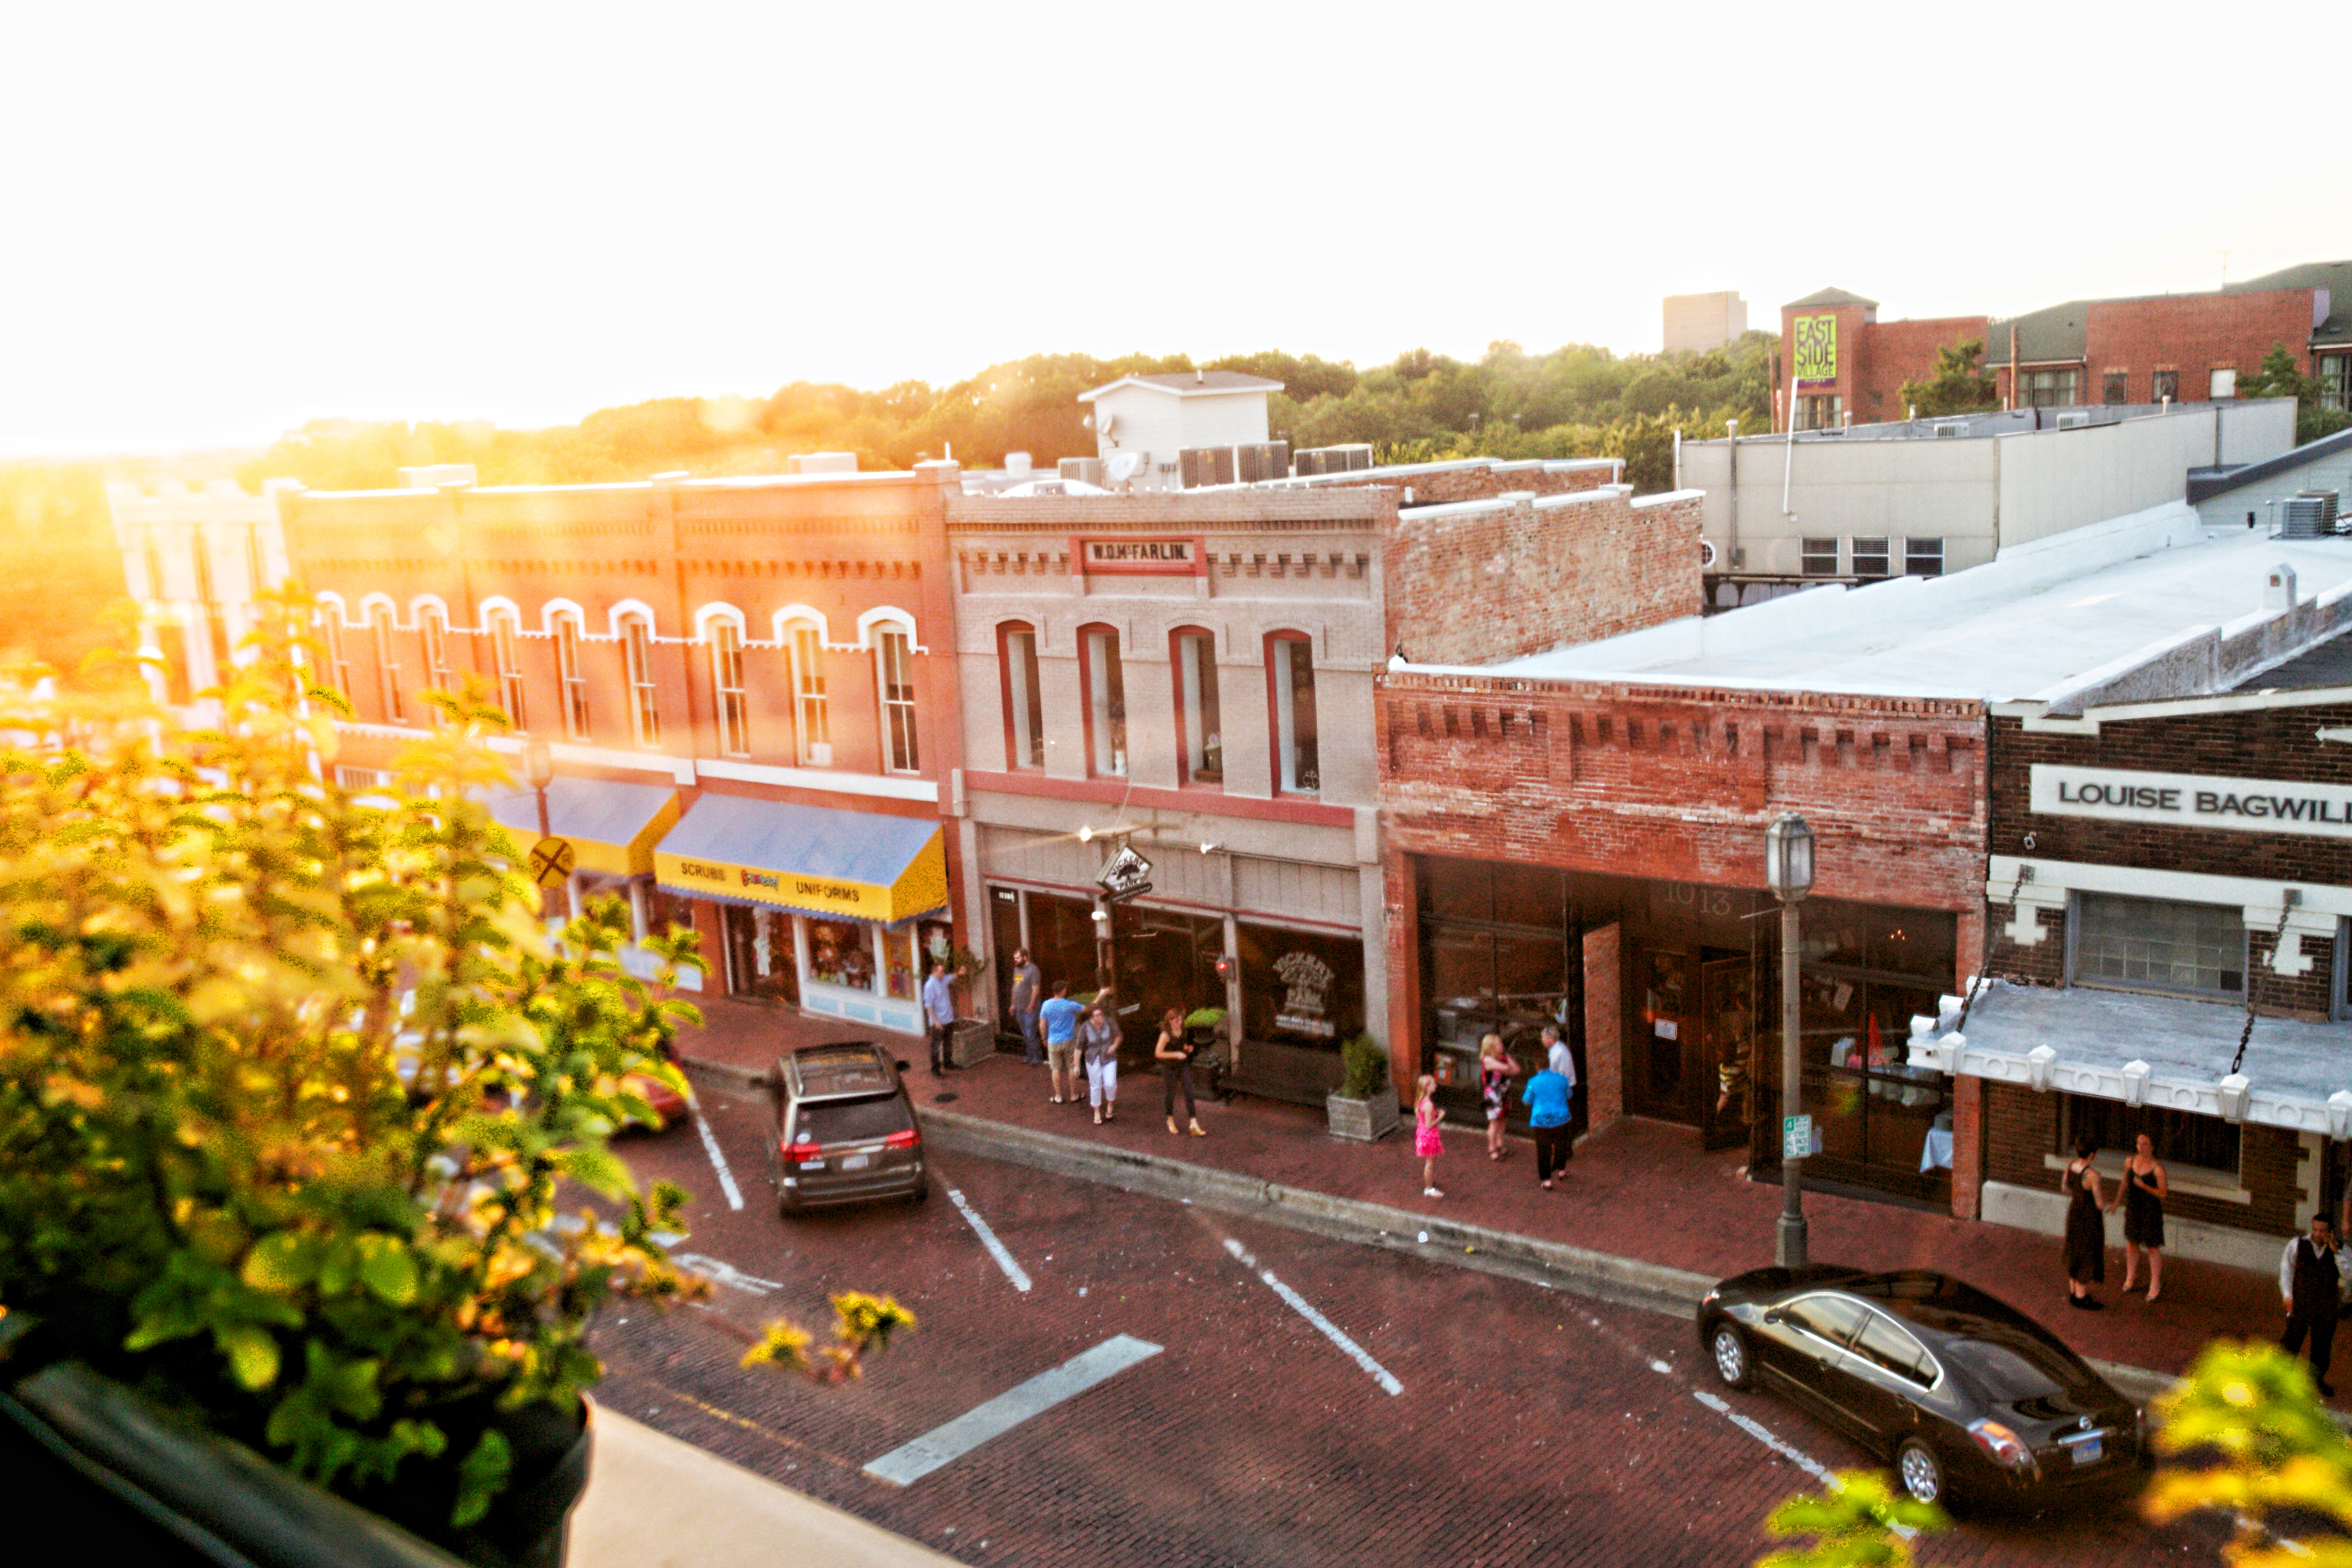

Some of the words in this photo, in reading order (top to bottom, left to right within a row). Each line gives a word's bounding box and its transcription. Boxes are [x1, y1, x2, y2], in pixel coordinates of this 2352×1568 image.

[1797, 319, 1833, 344] EAST
[1797, 340, 1833, 366] SIDE
[1797, 364, 1833, 377] VILLAGE
[2058, 780, 2181, 811] LOUISE
[1111, 855, 1144, 875] VICKERY
[681, 862, 726, 881] SCRUBS
[796, 881, 859, 902] UNIFORMS
[1119, 879, 1137, 890] PARK
[1666, 880, 1731, 915] 1013
[1272, 952, 1336, 980] VICKERY
